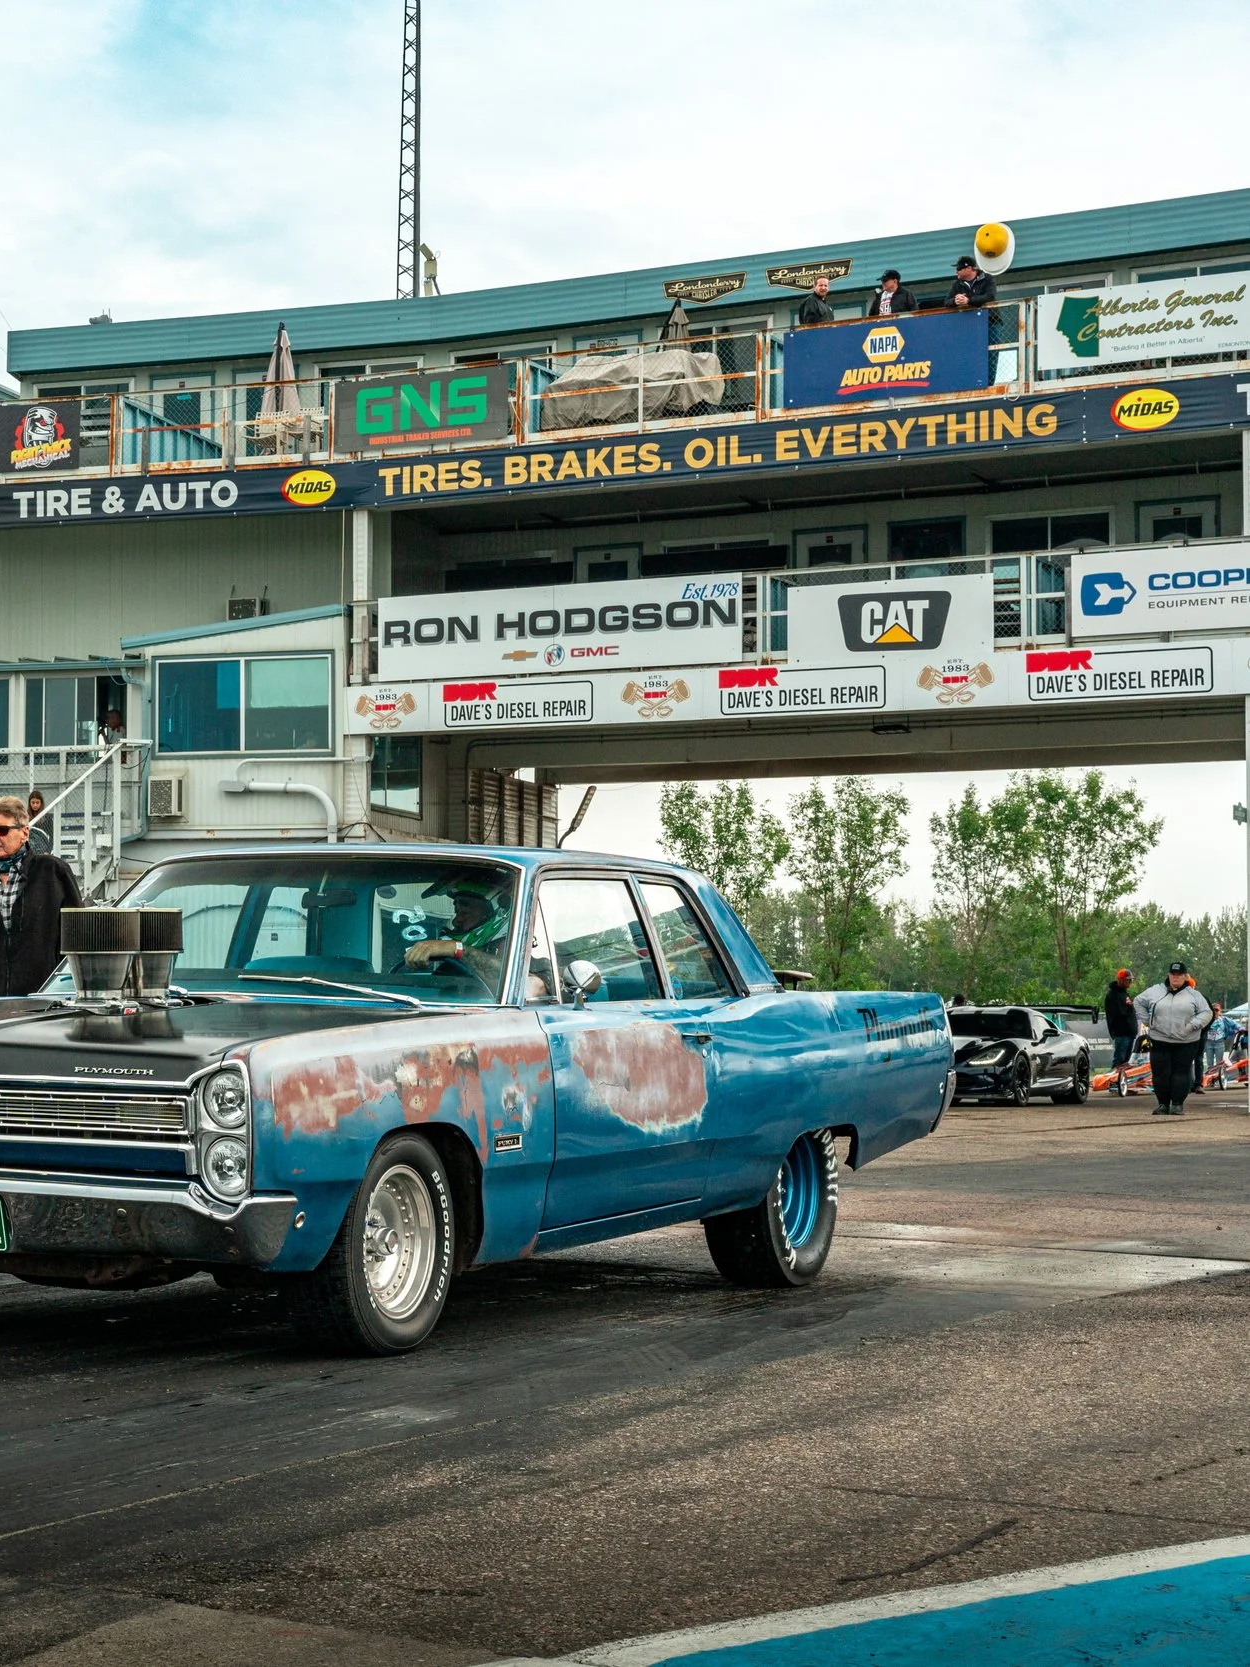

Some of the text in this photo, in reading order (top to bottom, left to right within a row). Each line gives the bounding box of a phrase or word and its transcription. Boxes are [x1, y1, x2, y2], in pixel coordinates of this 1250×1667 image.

[771, 265, 846, 280] Londonderry
[668, 278, 741, 293] Londonderry
[1083, 284, 1246, 319] Alberta General
[1077, 310, 1239, 342] Contractors Inc.
[870, 335, 898, 354] NAPA
[840, 361, 931, 387] AUTO PARTS
[356, 376, 487, 434] GNS
[1117, 397, 1174, 420] MIDAS
[369, 434, 404, 445] INDUSTRIAL
[379, 403, 1058, 496] TIRES. BRAKES. OIL. EVERYTHING
[286, 476, 332, 496] MIDAS
[13, 479, 238, 518] TIRE & AUTO
[1148, 568, 1250, 591] COOP
[1148, 595, 1250, 609] EQUIPMENT RE
[382, 598, 739, 648] RON HODGSON
[860, 599, 930, 643] CAT
[570, 645, 620, 658] GMC
[942, 664, 970, 673] 1983
[643, 680, 669, 688] 1983
[1036, 668, 1205, 694] DAVE'S DIESEL REPAIR
[375, 693, 397, 701] 1983
[728, 685, 878, 709] DAVE'S DIESEL REPAIR
[451, 700, 586, 721] DAVE'S DIESEL REPAIR
[74, 1066, 155, 1076] PLYMOUTH
